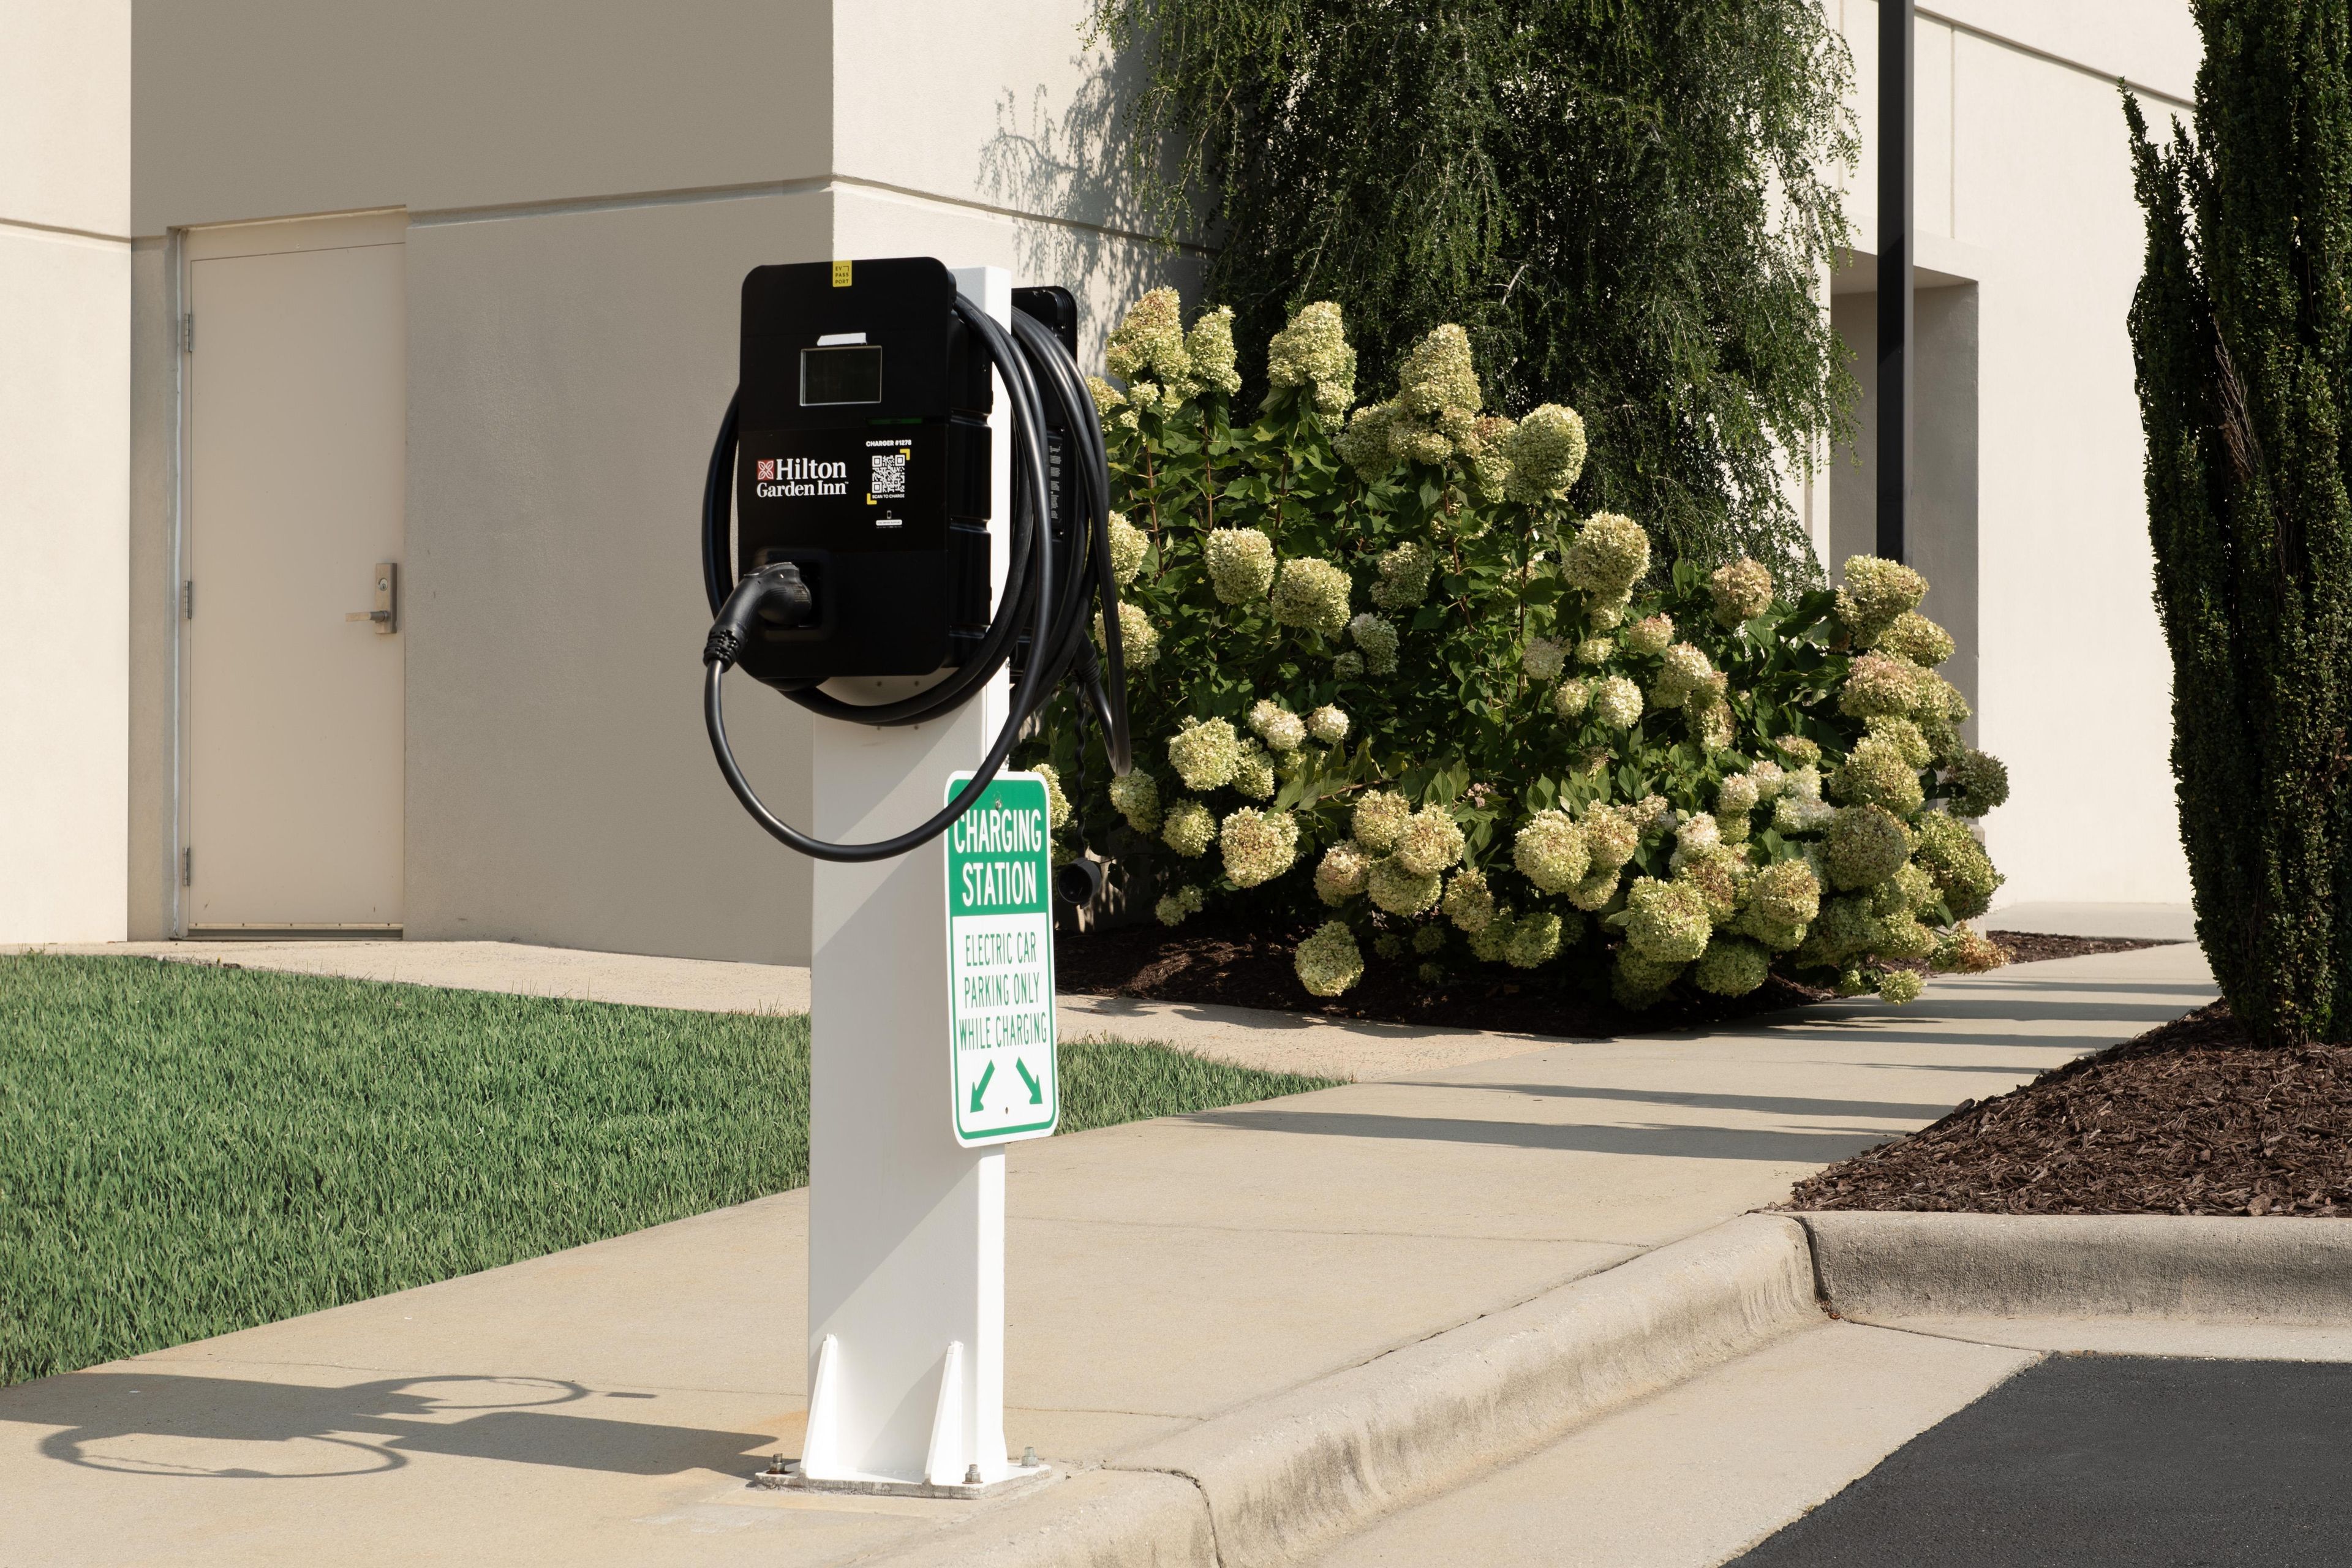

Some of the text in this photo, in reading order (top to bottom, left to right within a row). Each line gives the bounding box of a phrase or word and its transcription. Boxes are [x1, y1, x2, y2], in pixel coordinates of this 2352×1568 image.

[776, 458, 847, 480] Hilton
[756, 481, 815, 497] Garden
[954, 809, 1042, 854] CHARGING
[962, 861, 1037, 907] STATION
[965, 932, 1037, 967] ELECTRIC CAR
[964, 971, 1039, 1009] PARKING ONLY
[959, 1011, 1047, 1052] WHILE CHARGING
